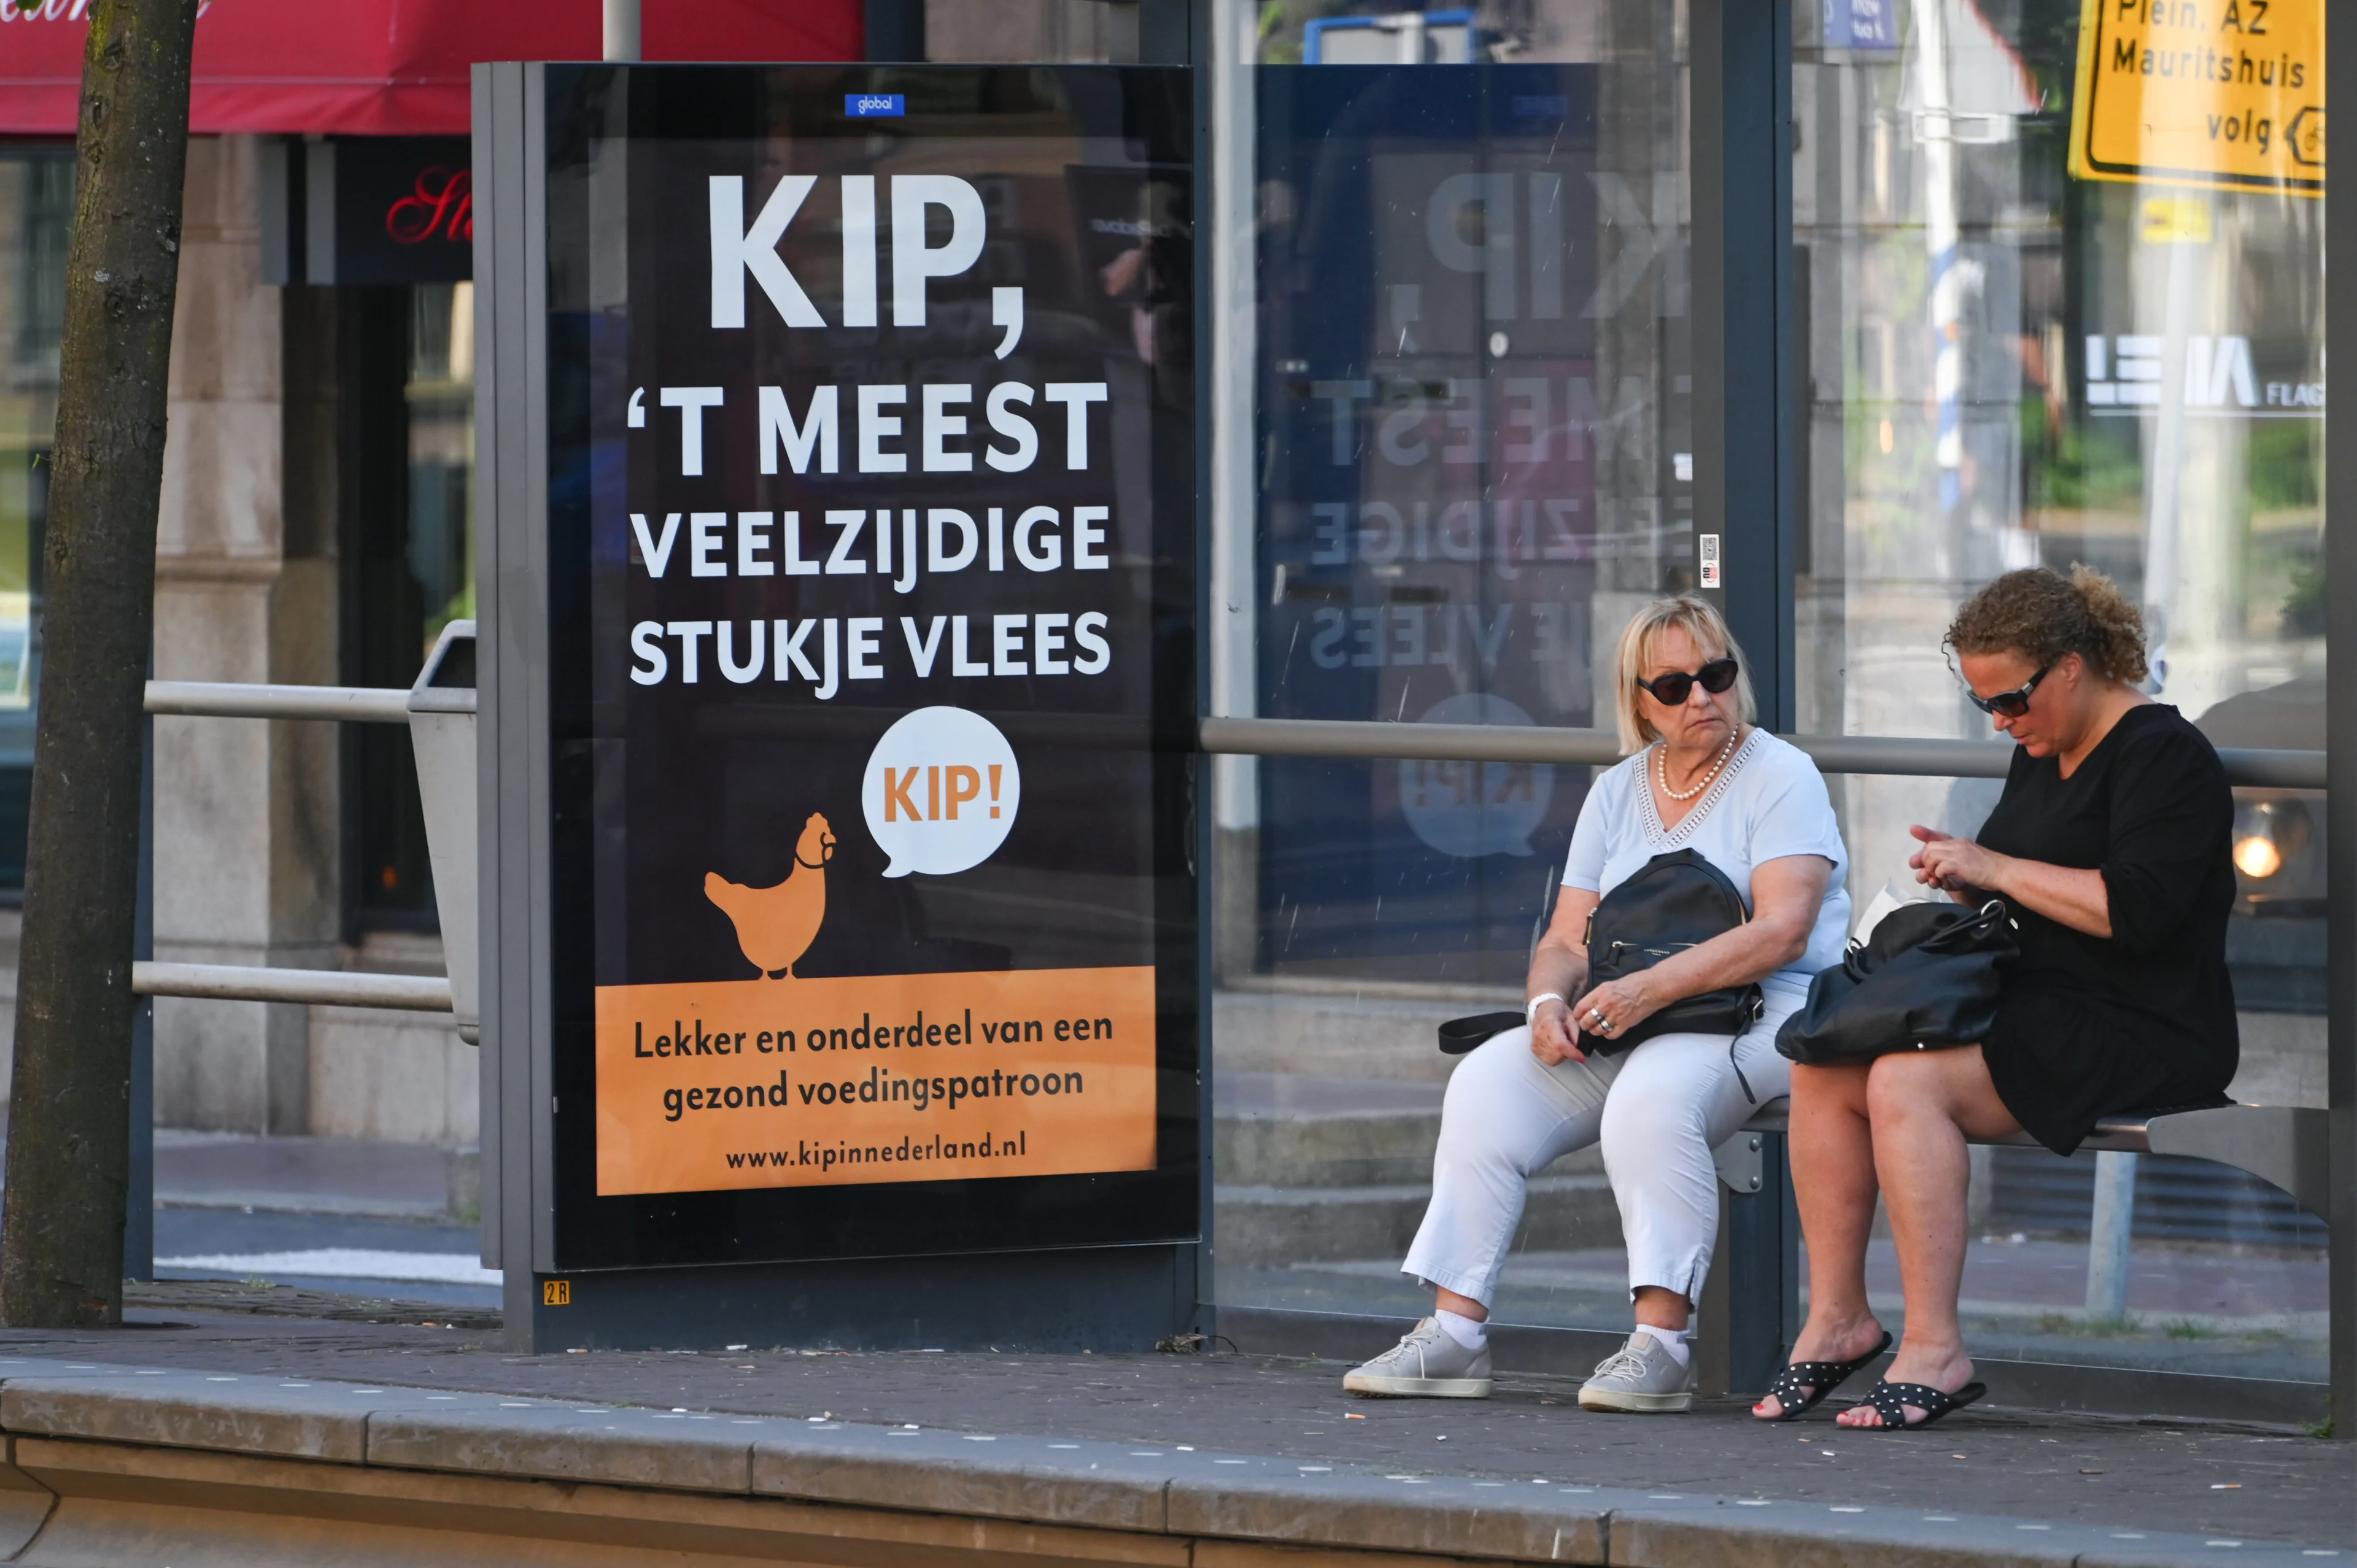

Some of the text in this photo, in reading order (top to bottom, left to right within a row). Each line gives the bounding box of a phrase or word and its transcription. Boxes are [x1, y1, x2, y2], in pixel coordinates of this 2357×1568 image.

[2221, 0, 2268, 35] AZ
[2112, 37, 2305, 88] Mauritshuis
[858, 96, 892, 115] global
[2207, 109, 2271, 153] volg
[710, 175, 1023, 360] KIP,
[759, 382, 1107, 474] MEEST
[630, 506, 1109, 593] VEELZIJDIGE
[630, 611, 1110, 700] STUKJE VLEES
[884, 764, 1002, 822] KIP!
[635, 1008, 1112, 1058] Lekker en onderdeel van een
[664, 1066, 1083, 1122] gezond voedingspatroon
[726, 1130, 1026, 1172] www.kipinnederland.nl
